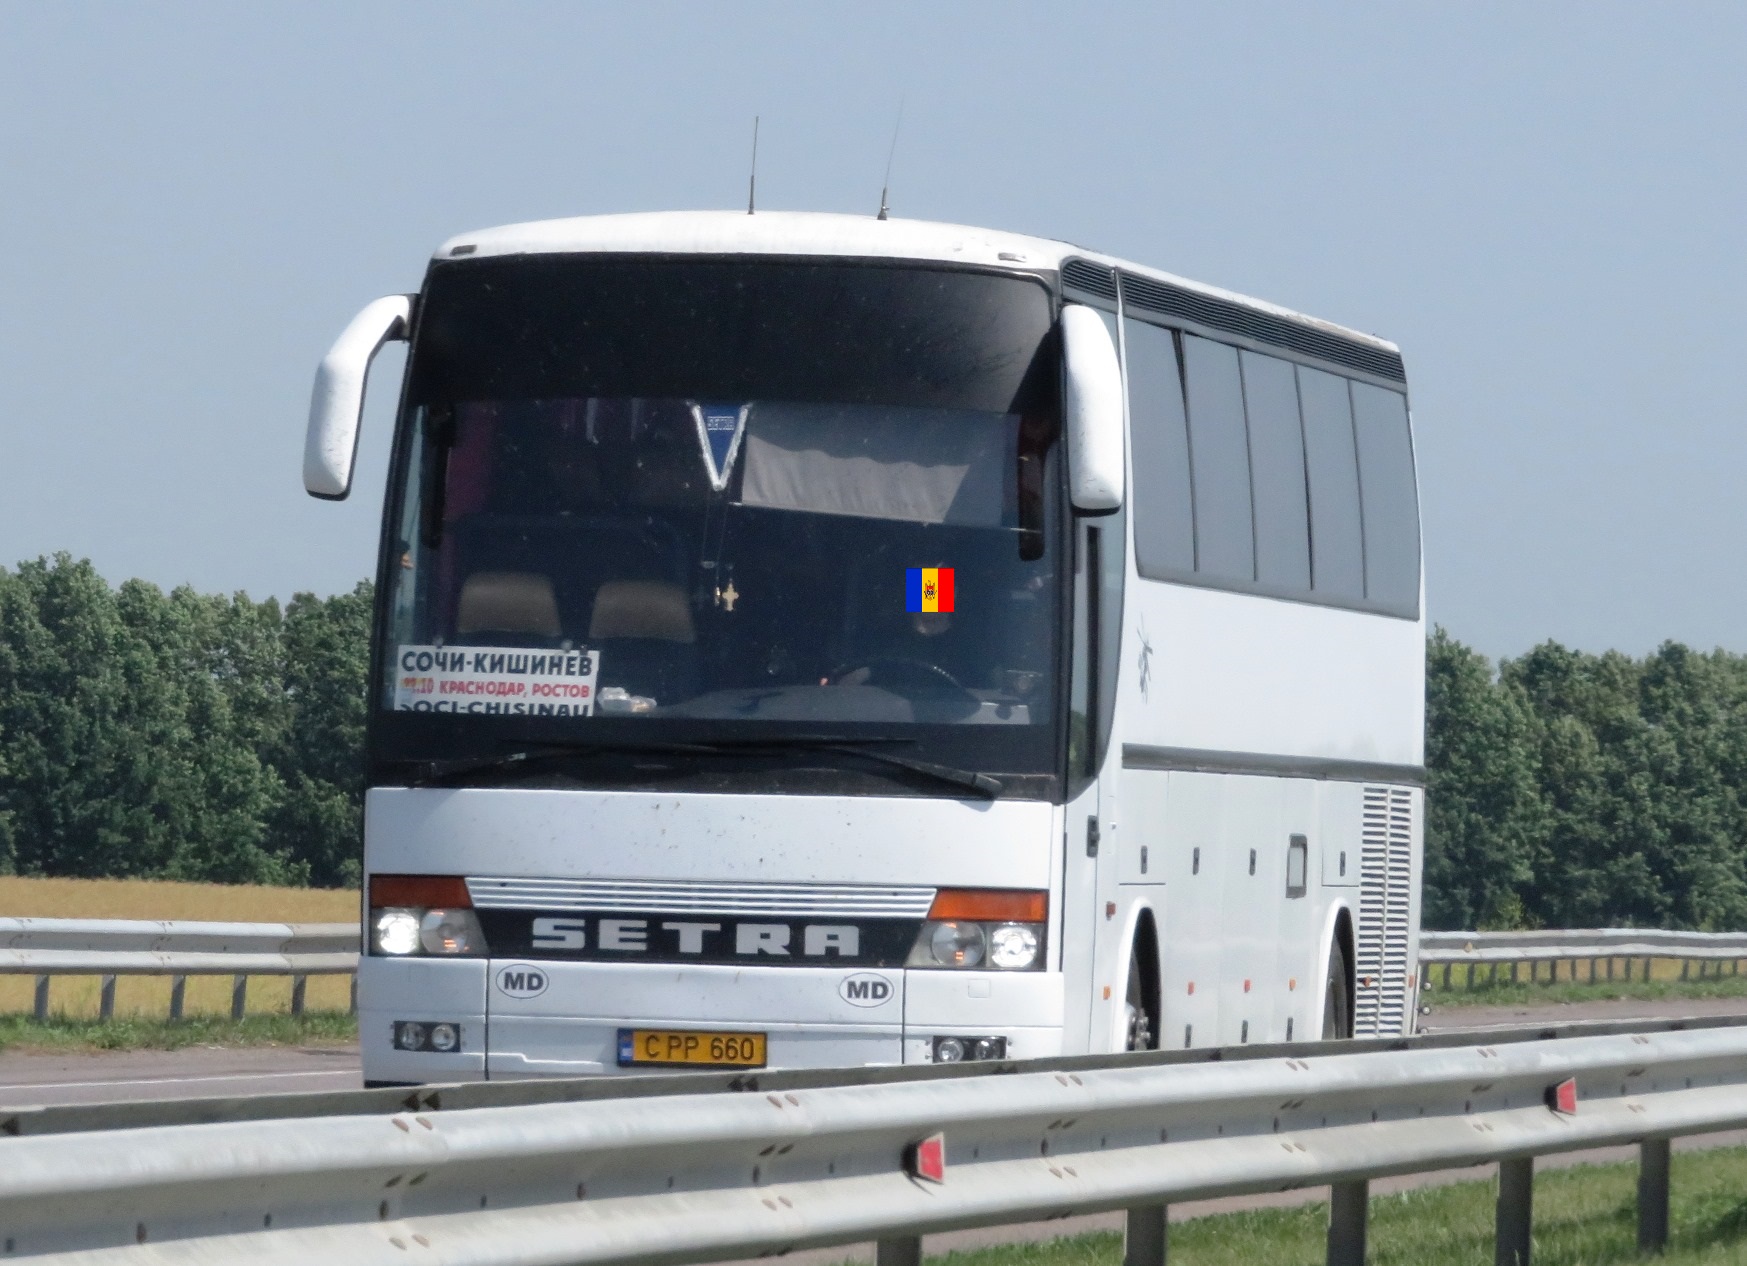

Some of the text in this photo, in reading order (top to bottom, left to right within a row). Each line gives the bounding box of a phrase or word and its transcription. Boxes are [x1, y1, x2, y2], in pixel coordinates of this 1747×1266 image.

[402, 651, 592, 676] СОЧИ-КИШИНЕВ
[439, 680, 527, 698] КРАСНОДАР,
[532, 683, 590, 698] РОСТОВ
[532, 917, 860, 957] SETRA
[504, 972, 544, 991] MD
[847, 981, 889, 999] MD
[710, 1037, 755, 1061] 660
